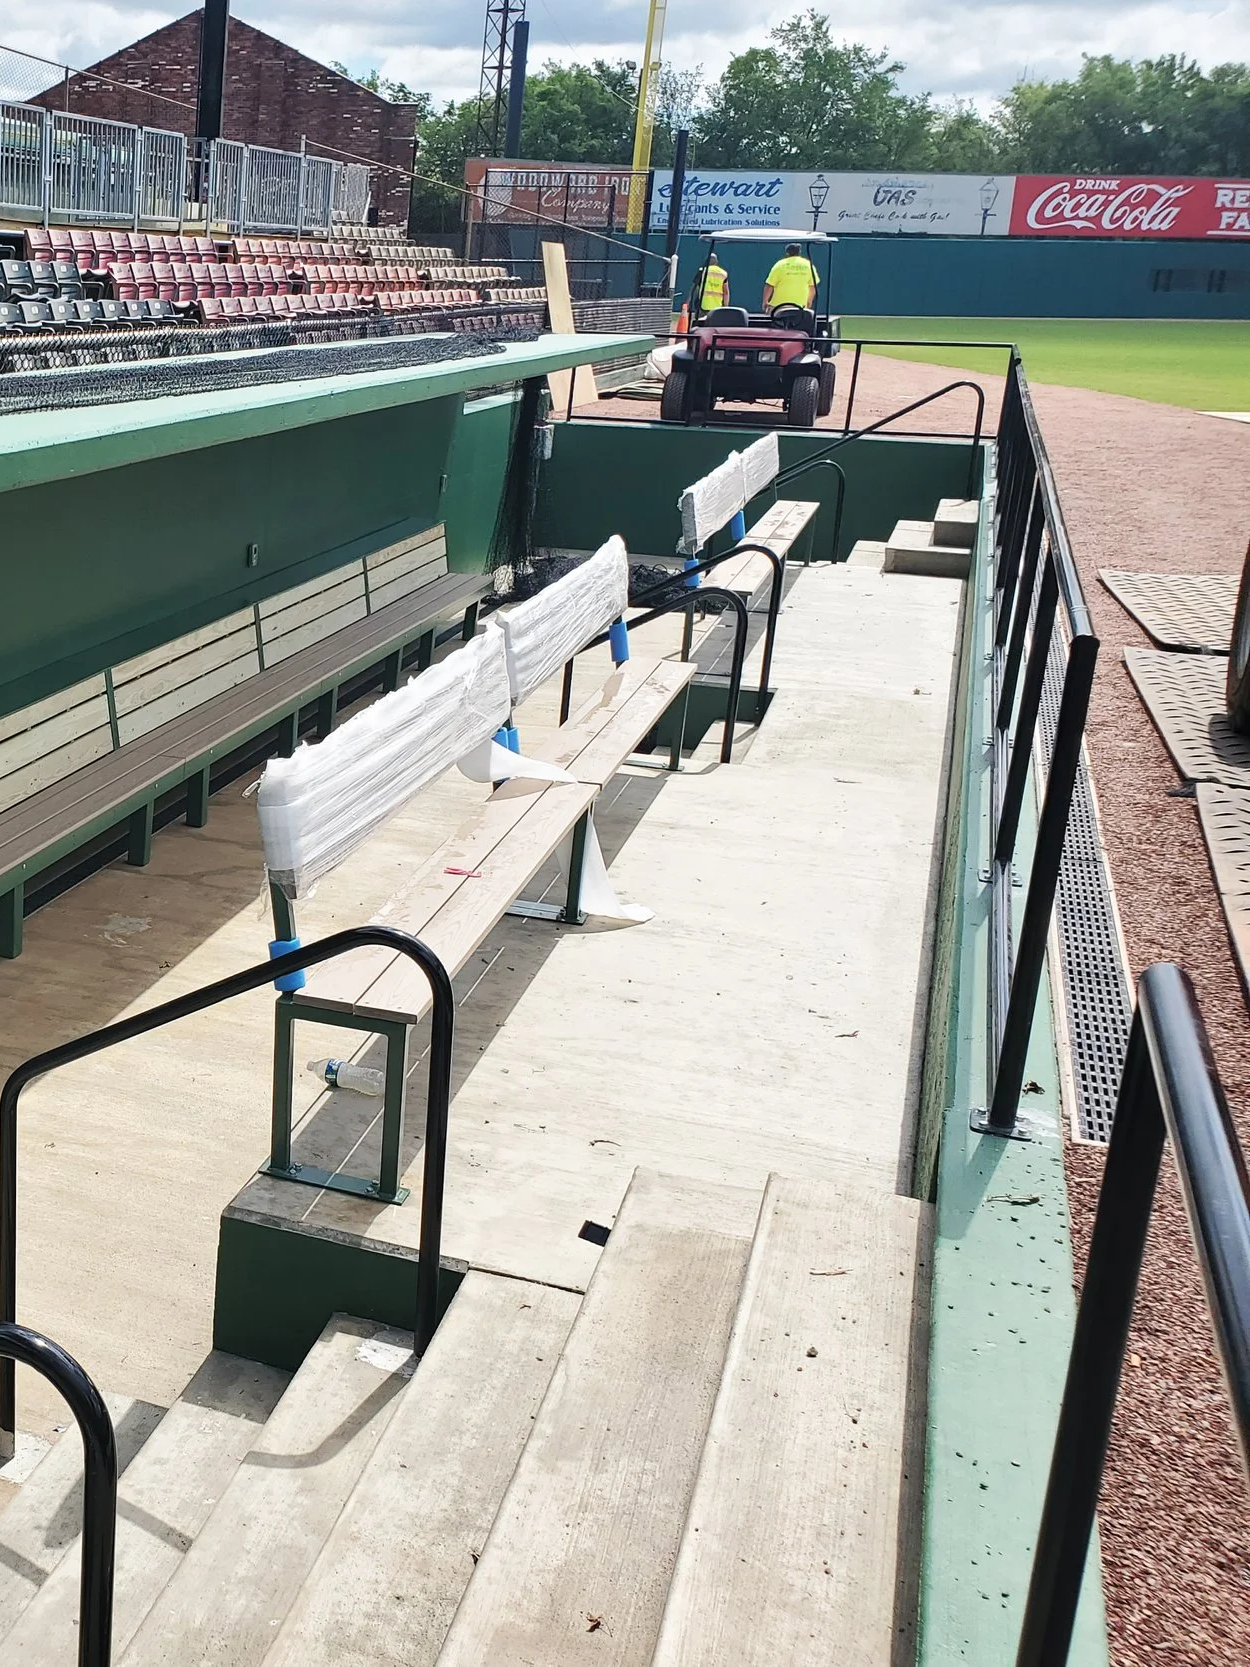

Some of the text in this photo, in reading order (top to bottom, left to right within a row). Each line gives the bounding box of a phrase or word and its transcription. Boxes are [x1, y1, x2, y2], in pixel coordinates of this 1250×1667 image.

[658, 175, 783, 198] Stewart
[1073, 179, 1120, 191] DRINK
[541, 190, 609, 214] Company
[1026, 181, 1195, 232] Coca-Cola
[1215, 189, 1250, 208] RE
[659, 202, 781, 215] Luricants & Service
[701, 217, 742, 226] Lubrication
[745, 218, 780, 227] Solutions
[1219, 211, 1250, 230] FA
